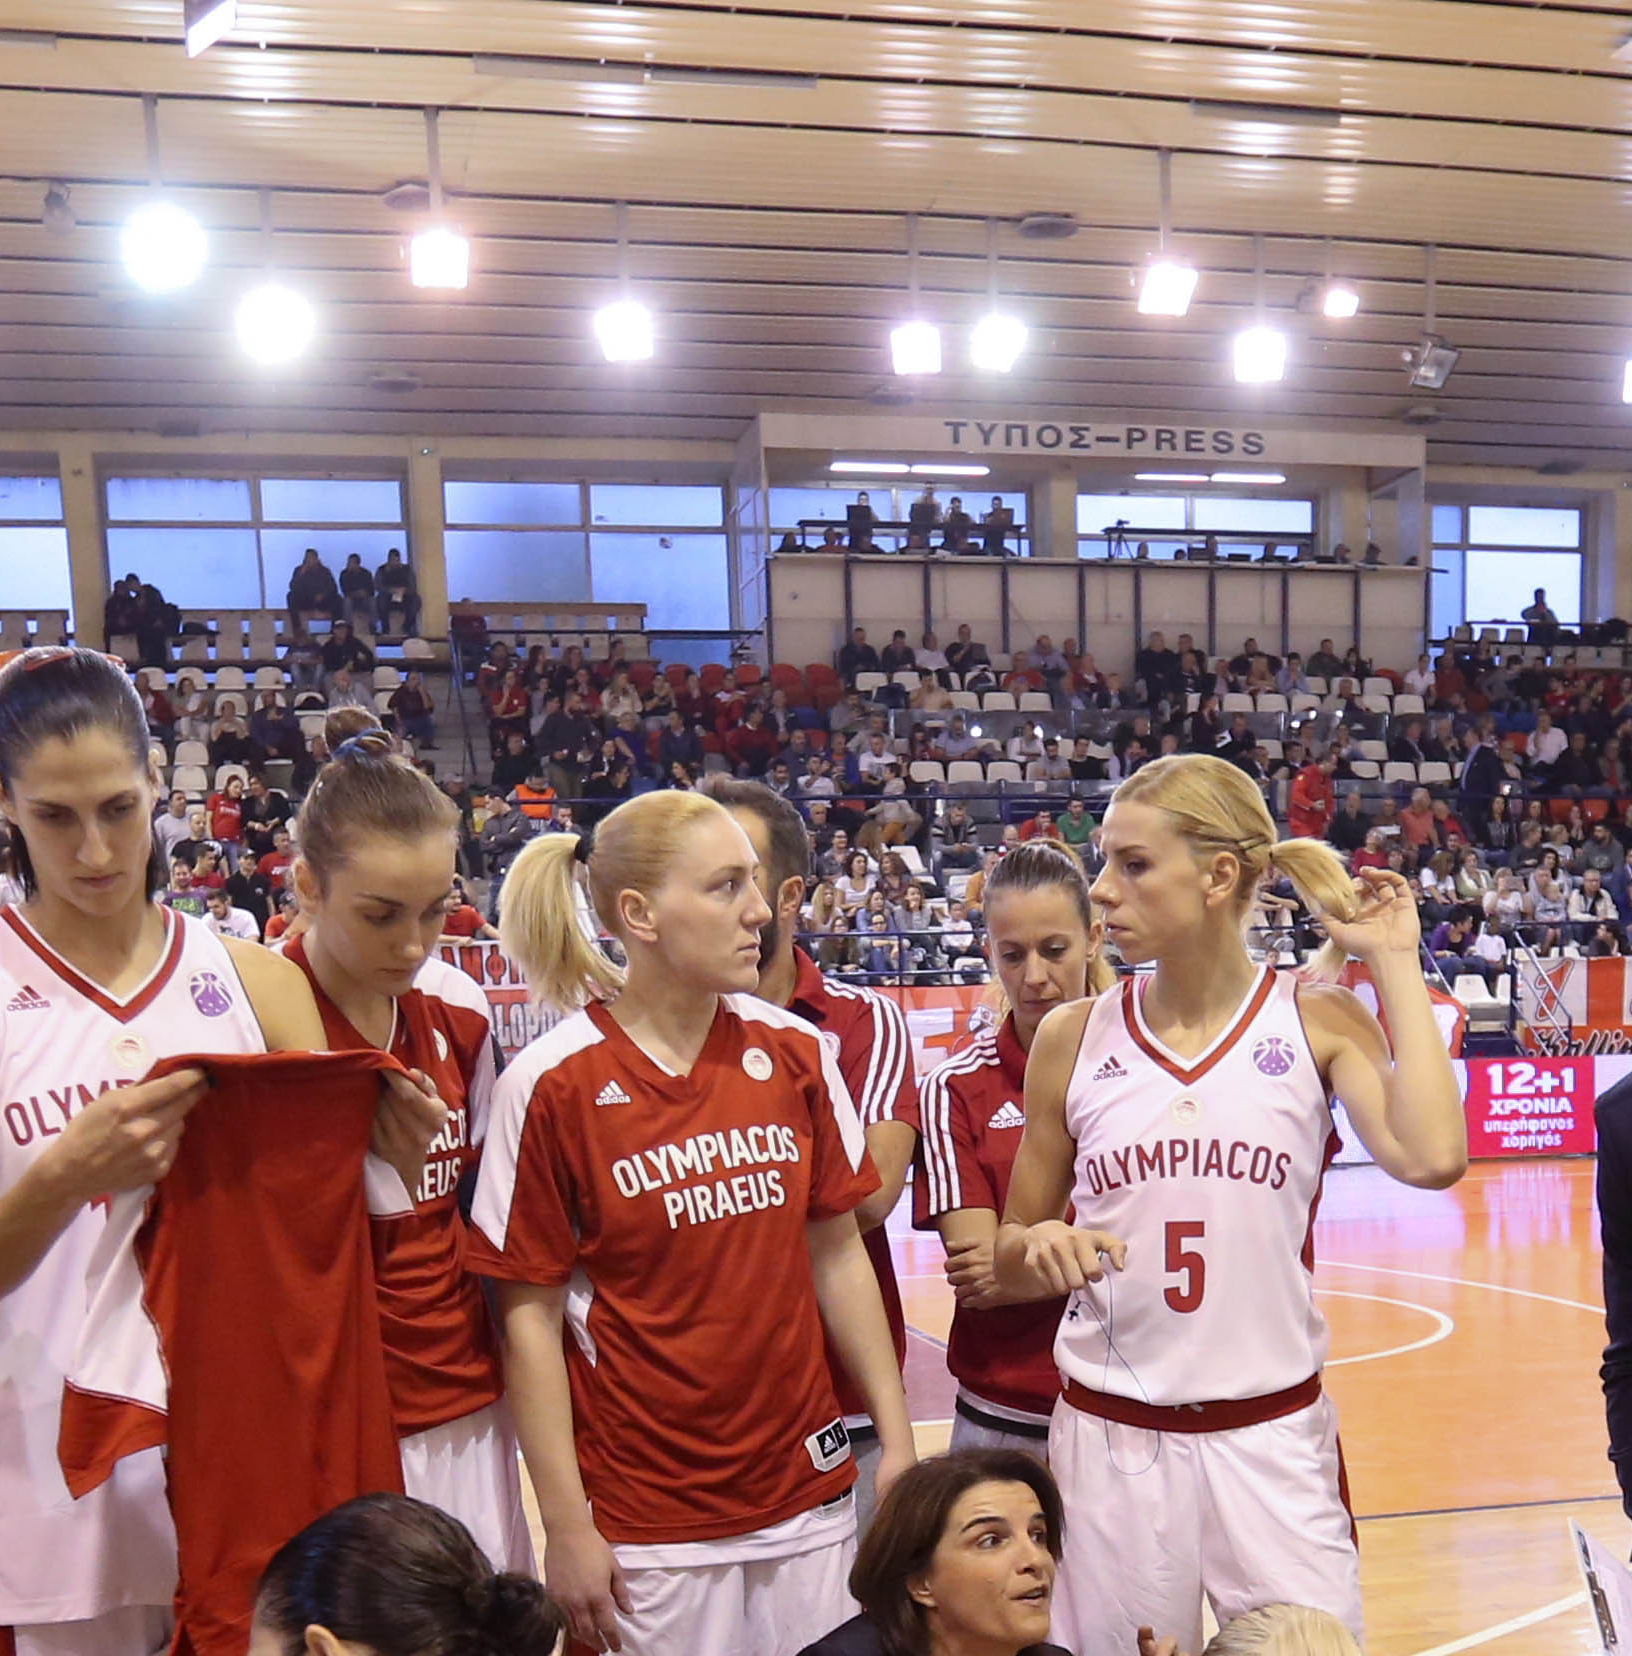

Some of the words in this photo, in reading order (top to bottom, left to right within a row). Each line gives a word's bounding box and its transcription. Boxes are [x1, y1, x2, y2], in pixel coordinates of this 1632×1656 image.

[7, 1000, 51, 1011] adidas
[1093, 1069, 1127, 1081] adidas
[1486, 1062, 1575, 1095] 12+1
[595, 1095, 631, 1106] adidas
[1489, 1097, 1573, 1115] ΧΡΟΝΙΑ
[612, 1124, 799, 1198] OLYMPIACOS
[1086, 1138, 1291, 1195] OLYMPIACOS
[663, 1169, 785, 1229] PIRAEUS
[1164, 1221, 1205, 1313] 5
